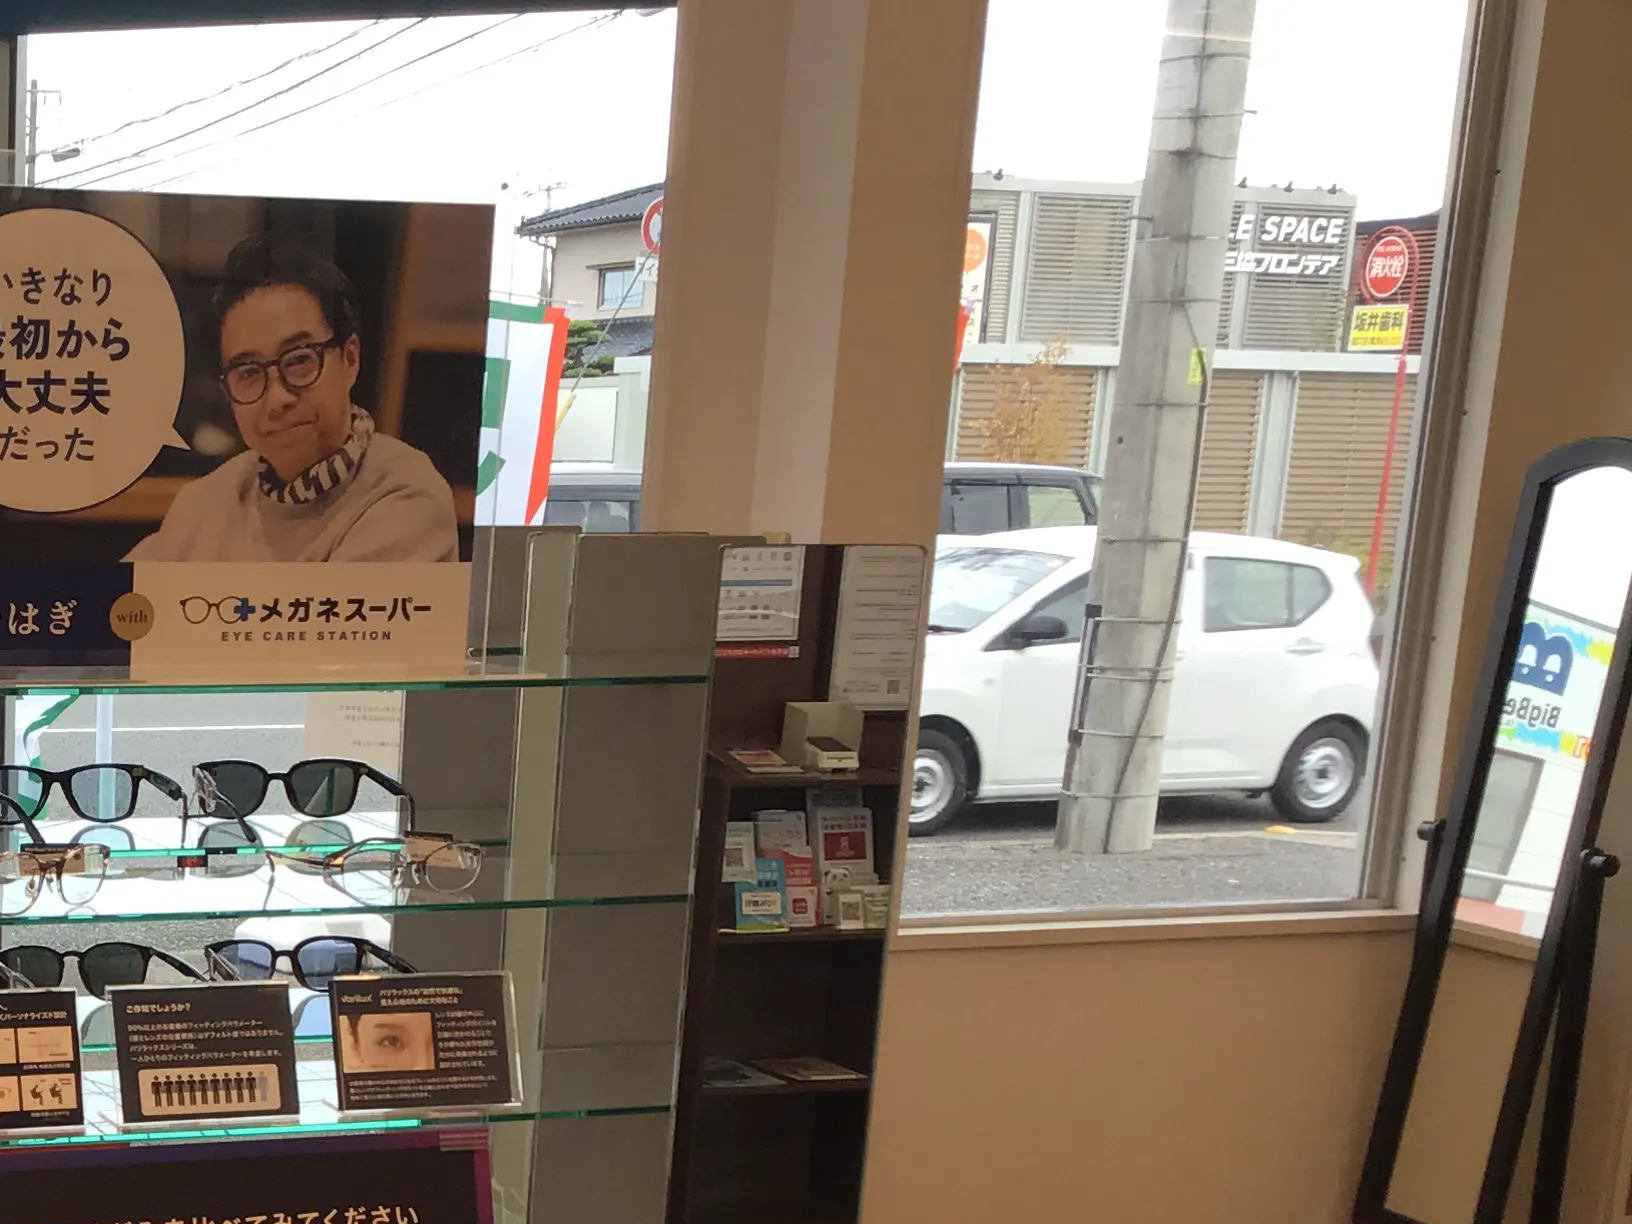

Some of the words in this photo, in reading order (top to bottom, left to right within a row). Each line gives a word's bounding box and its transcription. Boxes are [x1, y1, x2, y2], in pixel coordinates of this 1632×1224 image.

[1261, 216, 1345, 244] SPACE
[1369, 256, 1405, 279] 消火栓
[115, 606, 148, 625] with
[259, 597, 432, 623] メガネスーパー
[221, 631, 254, 642] EYE
[263, 631, 307, 642] CARE
[316, 630, 392, 641] STATION
